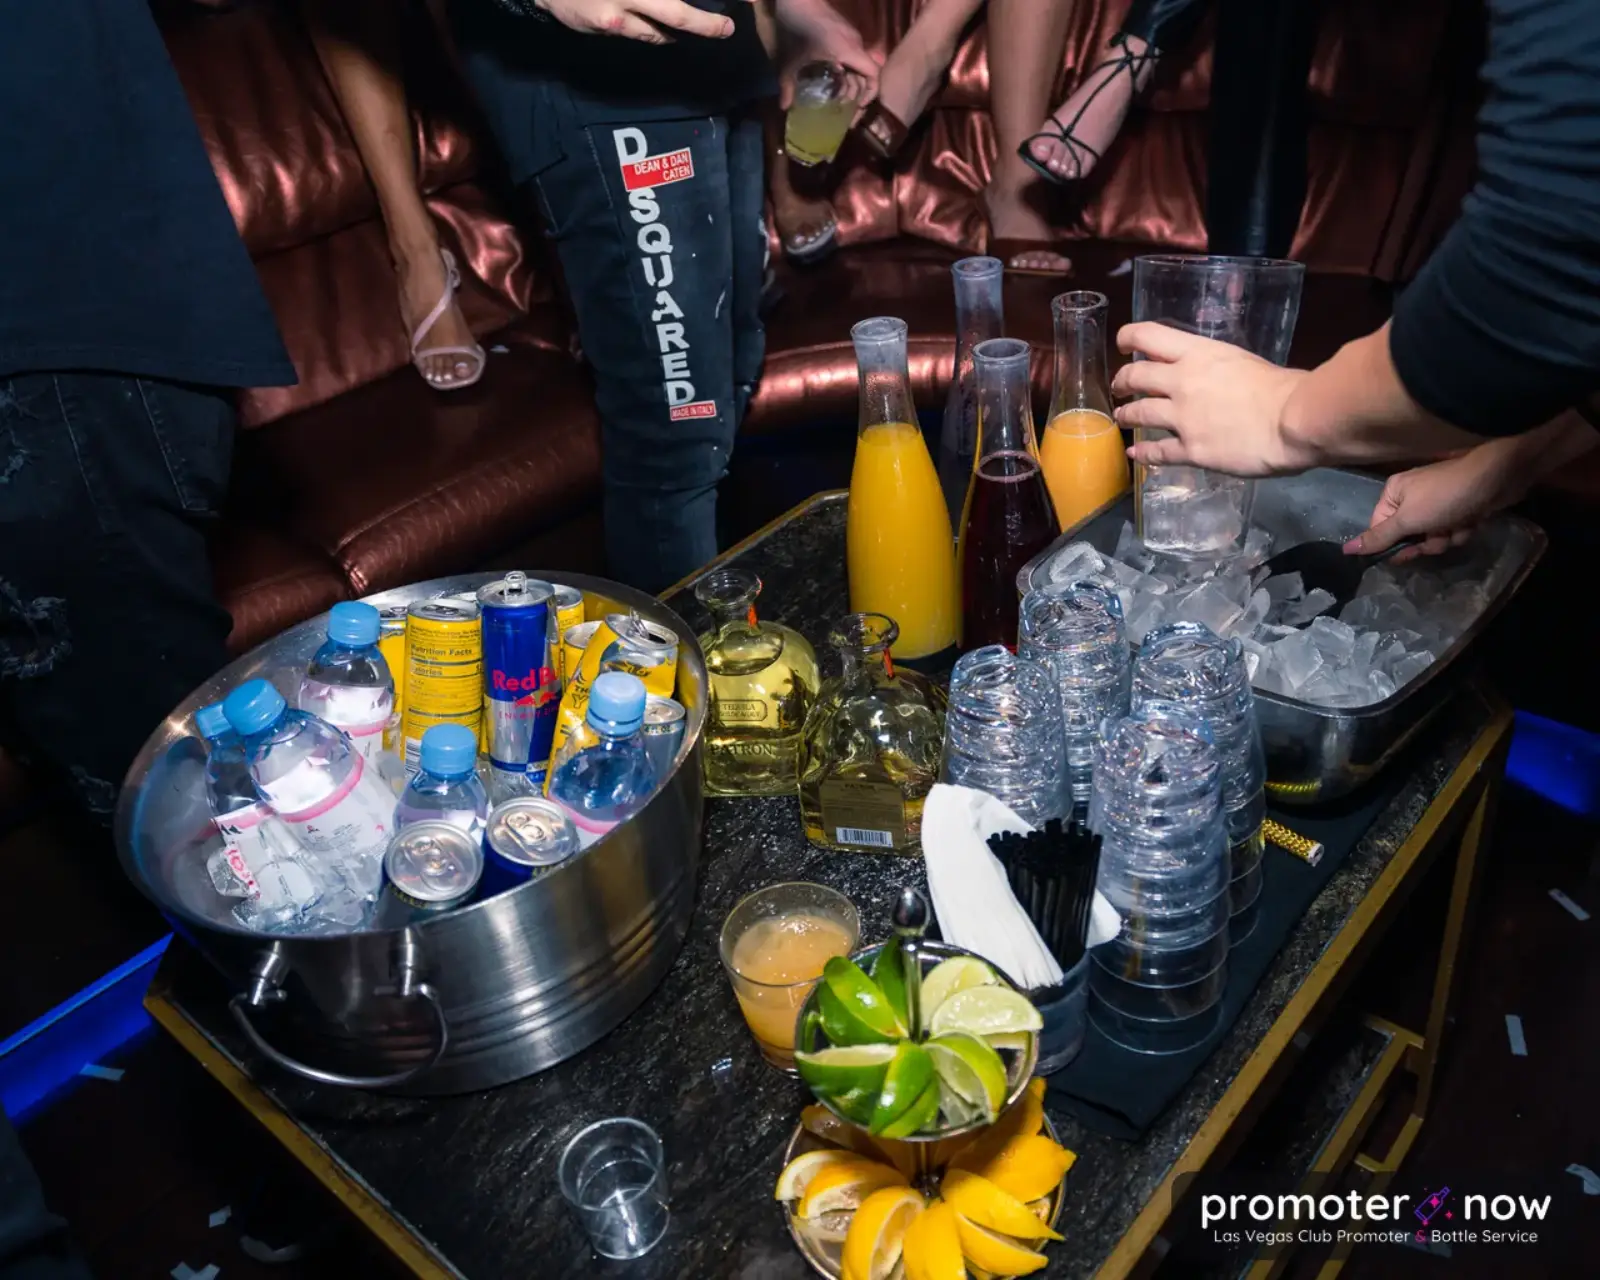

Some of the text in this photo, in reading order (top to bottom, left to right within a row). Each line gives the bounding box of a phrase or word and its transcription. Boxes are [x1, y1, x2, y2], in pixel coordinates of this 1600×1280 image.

[634, 152, 689, 175] DEAN & DAN
[662, 165, 691, 180] CATEN
[449, 648, 473, 656] Facts
[492, 668, 536, 691] Red
